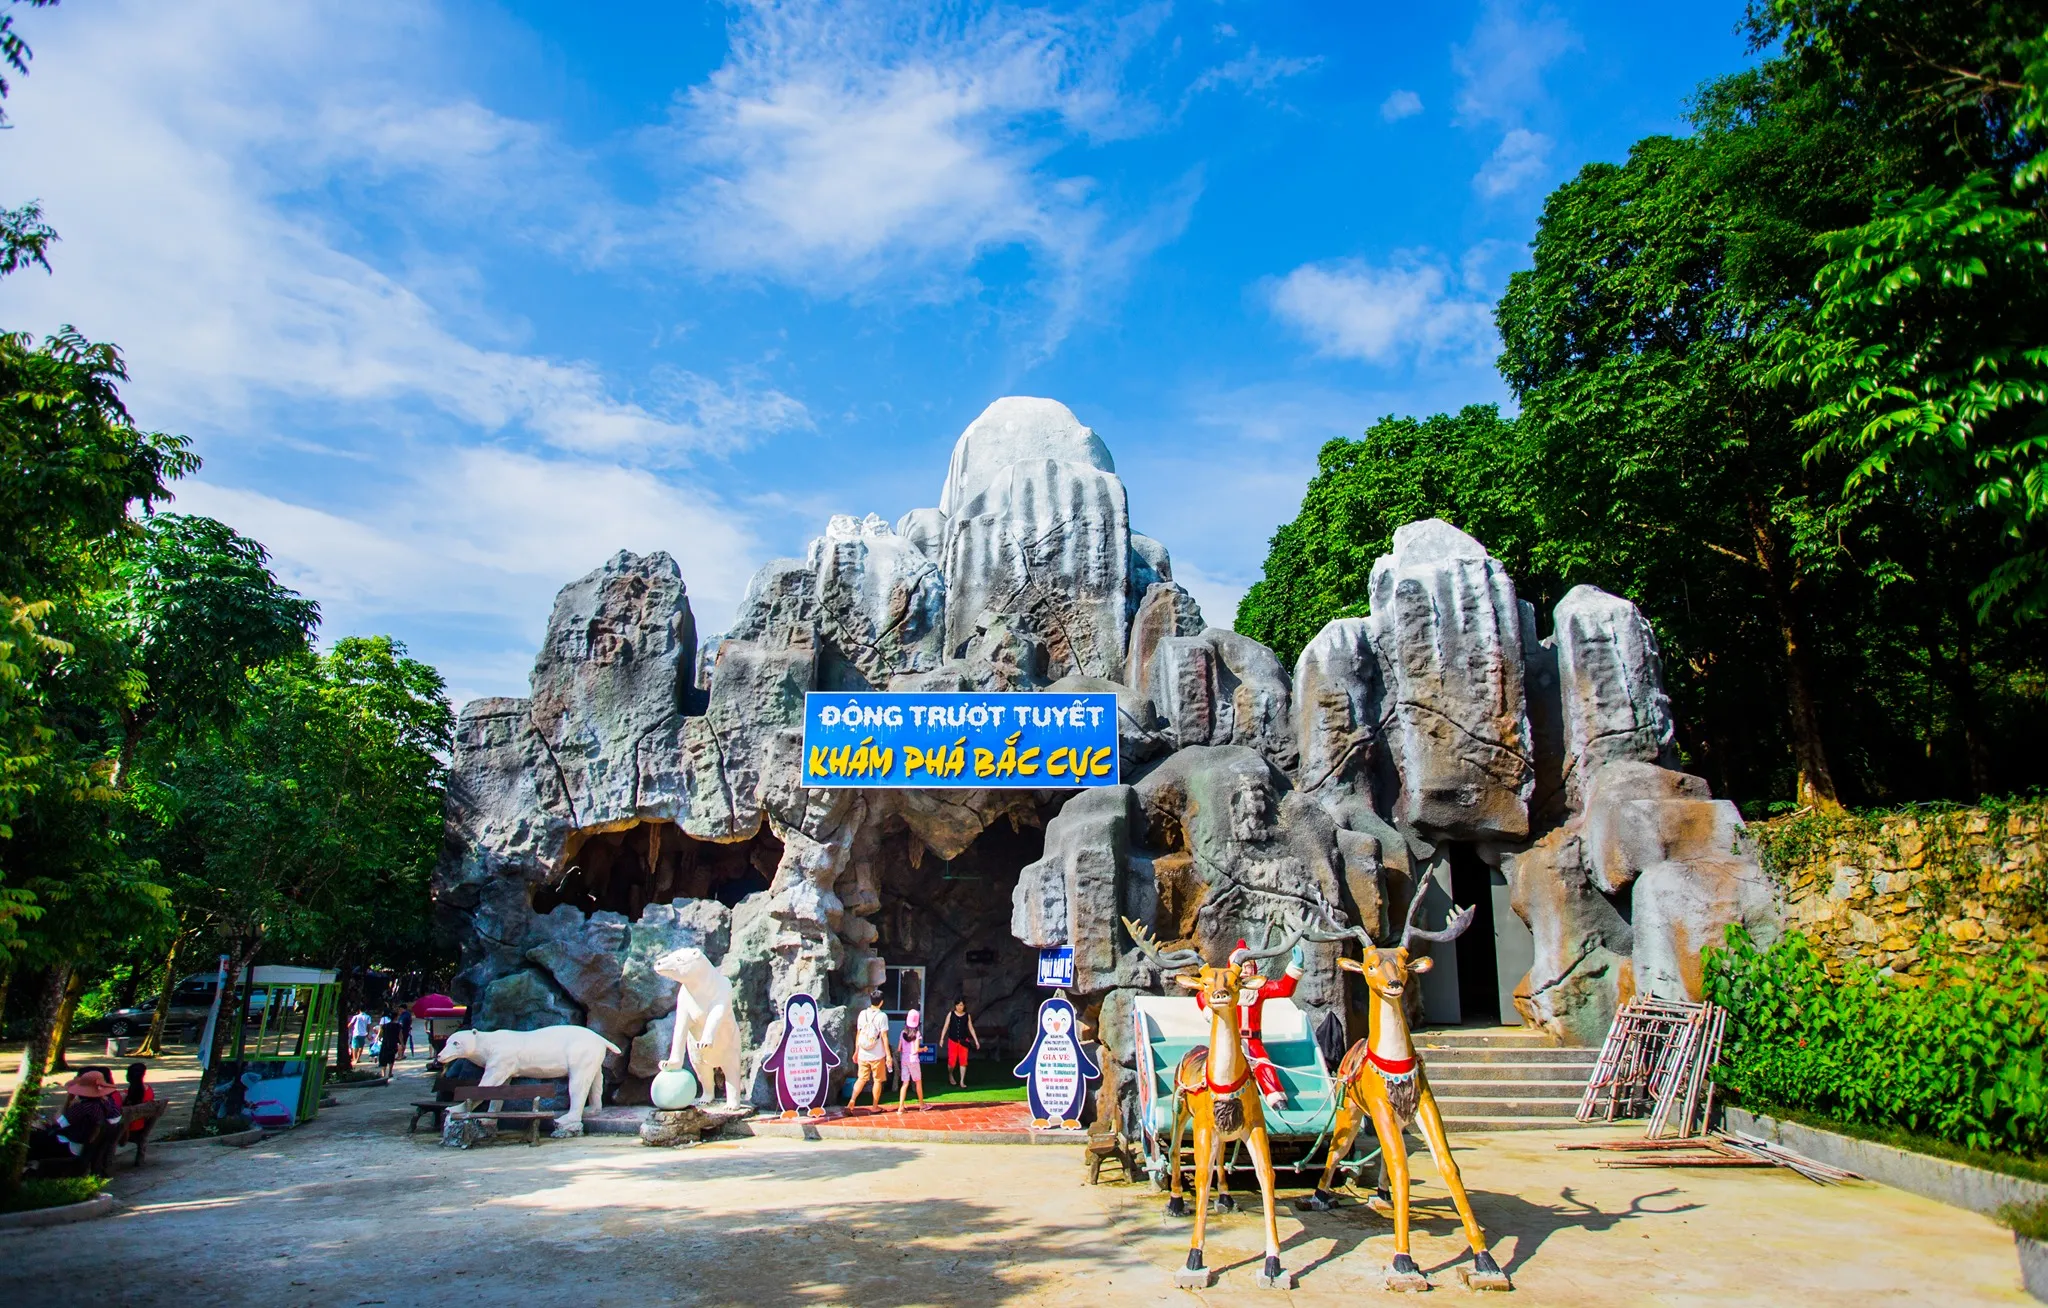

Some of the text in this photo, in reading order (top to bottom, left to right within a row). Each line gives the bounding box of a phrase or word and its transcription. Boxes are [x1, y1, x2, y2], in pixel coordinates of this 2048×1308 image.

[818, 698, 1104, 732] ĐỘNG TRƯỢT TUYẾT
[808, 730, 1112, 783] KHÁM PHÁ BẮC CỰC
